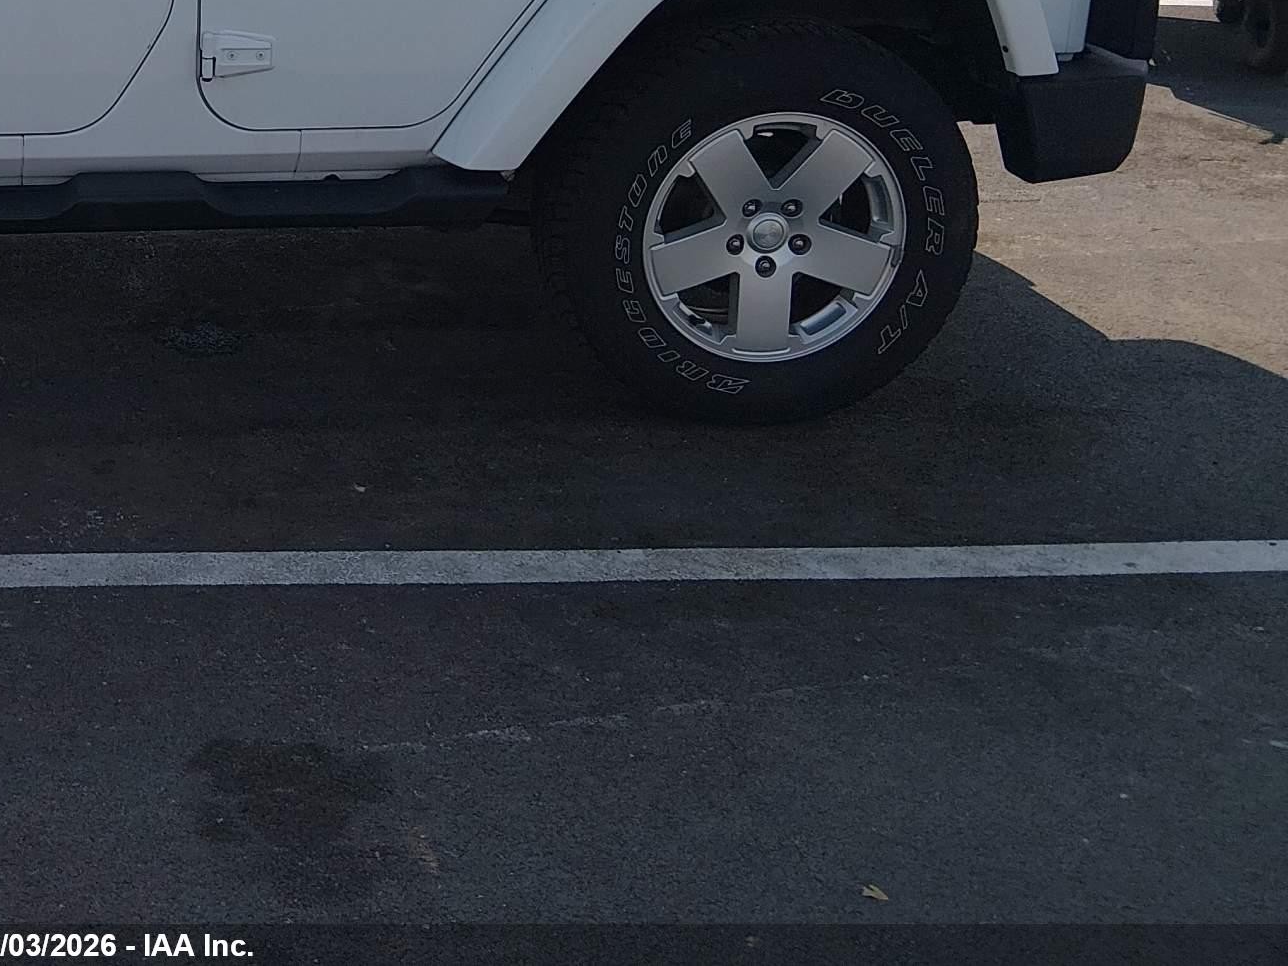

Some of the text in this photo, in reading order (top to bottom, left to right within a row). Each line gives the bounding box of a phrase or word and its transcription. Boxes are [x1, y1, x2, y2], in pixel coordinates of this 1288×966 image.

[819, 89, 945, 256] DUELER
[615, 119, 751, 394] BRIDGESTONE
[877, 268, 929, 355] A/T
